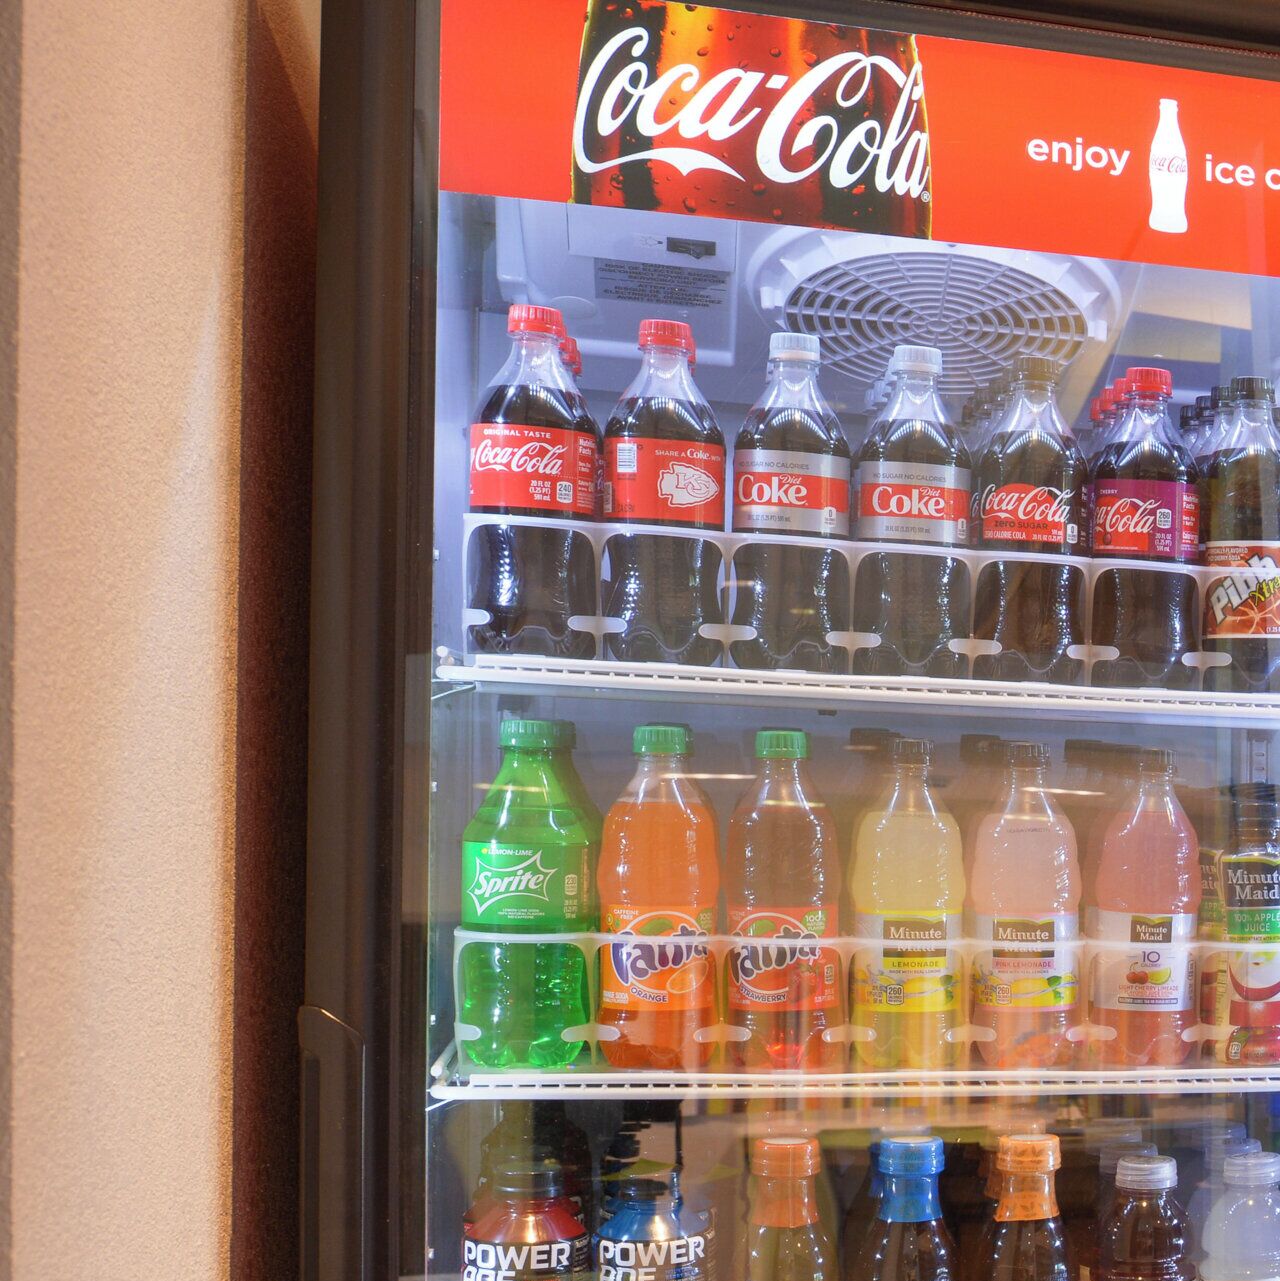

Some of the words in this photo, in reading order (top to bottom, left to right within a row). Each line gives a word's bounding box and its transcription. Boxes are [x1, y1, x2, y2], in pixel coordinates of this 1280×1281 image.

[574, 26, 930, 199] Coca-Cola
[1026, 136, 1131, 177] enjoy
[1205, 153, 1256, 188] ice
[483, 428, 521, 437] ORIGINAL
[524, 431, 551, 439] TASTE
[475, 438, 569, 475] Coca-Cola
[687, 448, 708, 461] Coke
[779, 473, 802, 486] Diet
[738, 475, 808, 506] Coke
[919, 486, 941, 498] Diet
[871, 485, 946, 518] Coke
[981, 483, 1076, 524] Coca-Cola
[1017, 520, 1049, 530] SUGAR
[487, 848, 533, 857] LEMON-LIME
[473, 868, 544, 898] Sprite
[1235, 885, 1280, 901] Maid
[1253, 912, 1280, 922] APPLE
[889, 927, 942, 940] Minute
[998, 927, 1050, 941] Minute
[1135, 924, 1168, 934] Minute
[1244, 922, 1270, 932] JUICE
[1139, 932, 1164, 941] Maid
[610, 924, 708, 987] Fanta
[730, 925, 819, 985] Fanta
[1141, 950, 1161, 963] 10
[892, 960, 940, 969] LEMONADE
[1015, 961, 1052, 969] LEMONADE
[630, 987, 668, 1003] ORANGE
[739, 986, 787, 1004] STRAWBERRY
[464, 1239, 571, 1271] POWER
[600, 1235, 705, 1268] POWER
